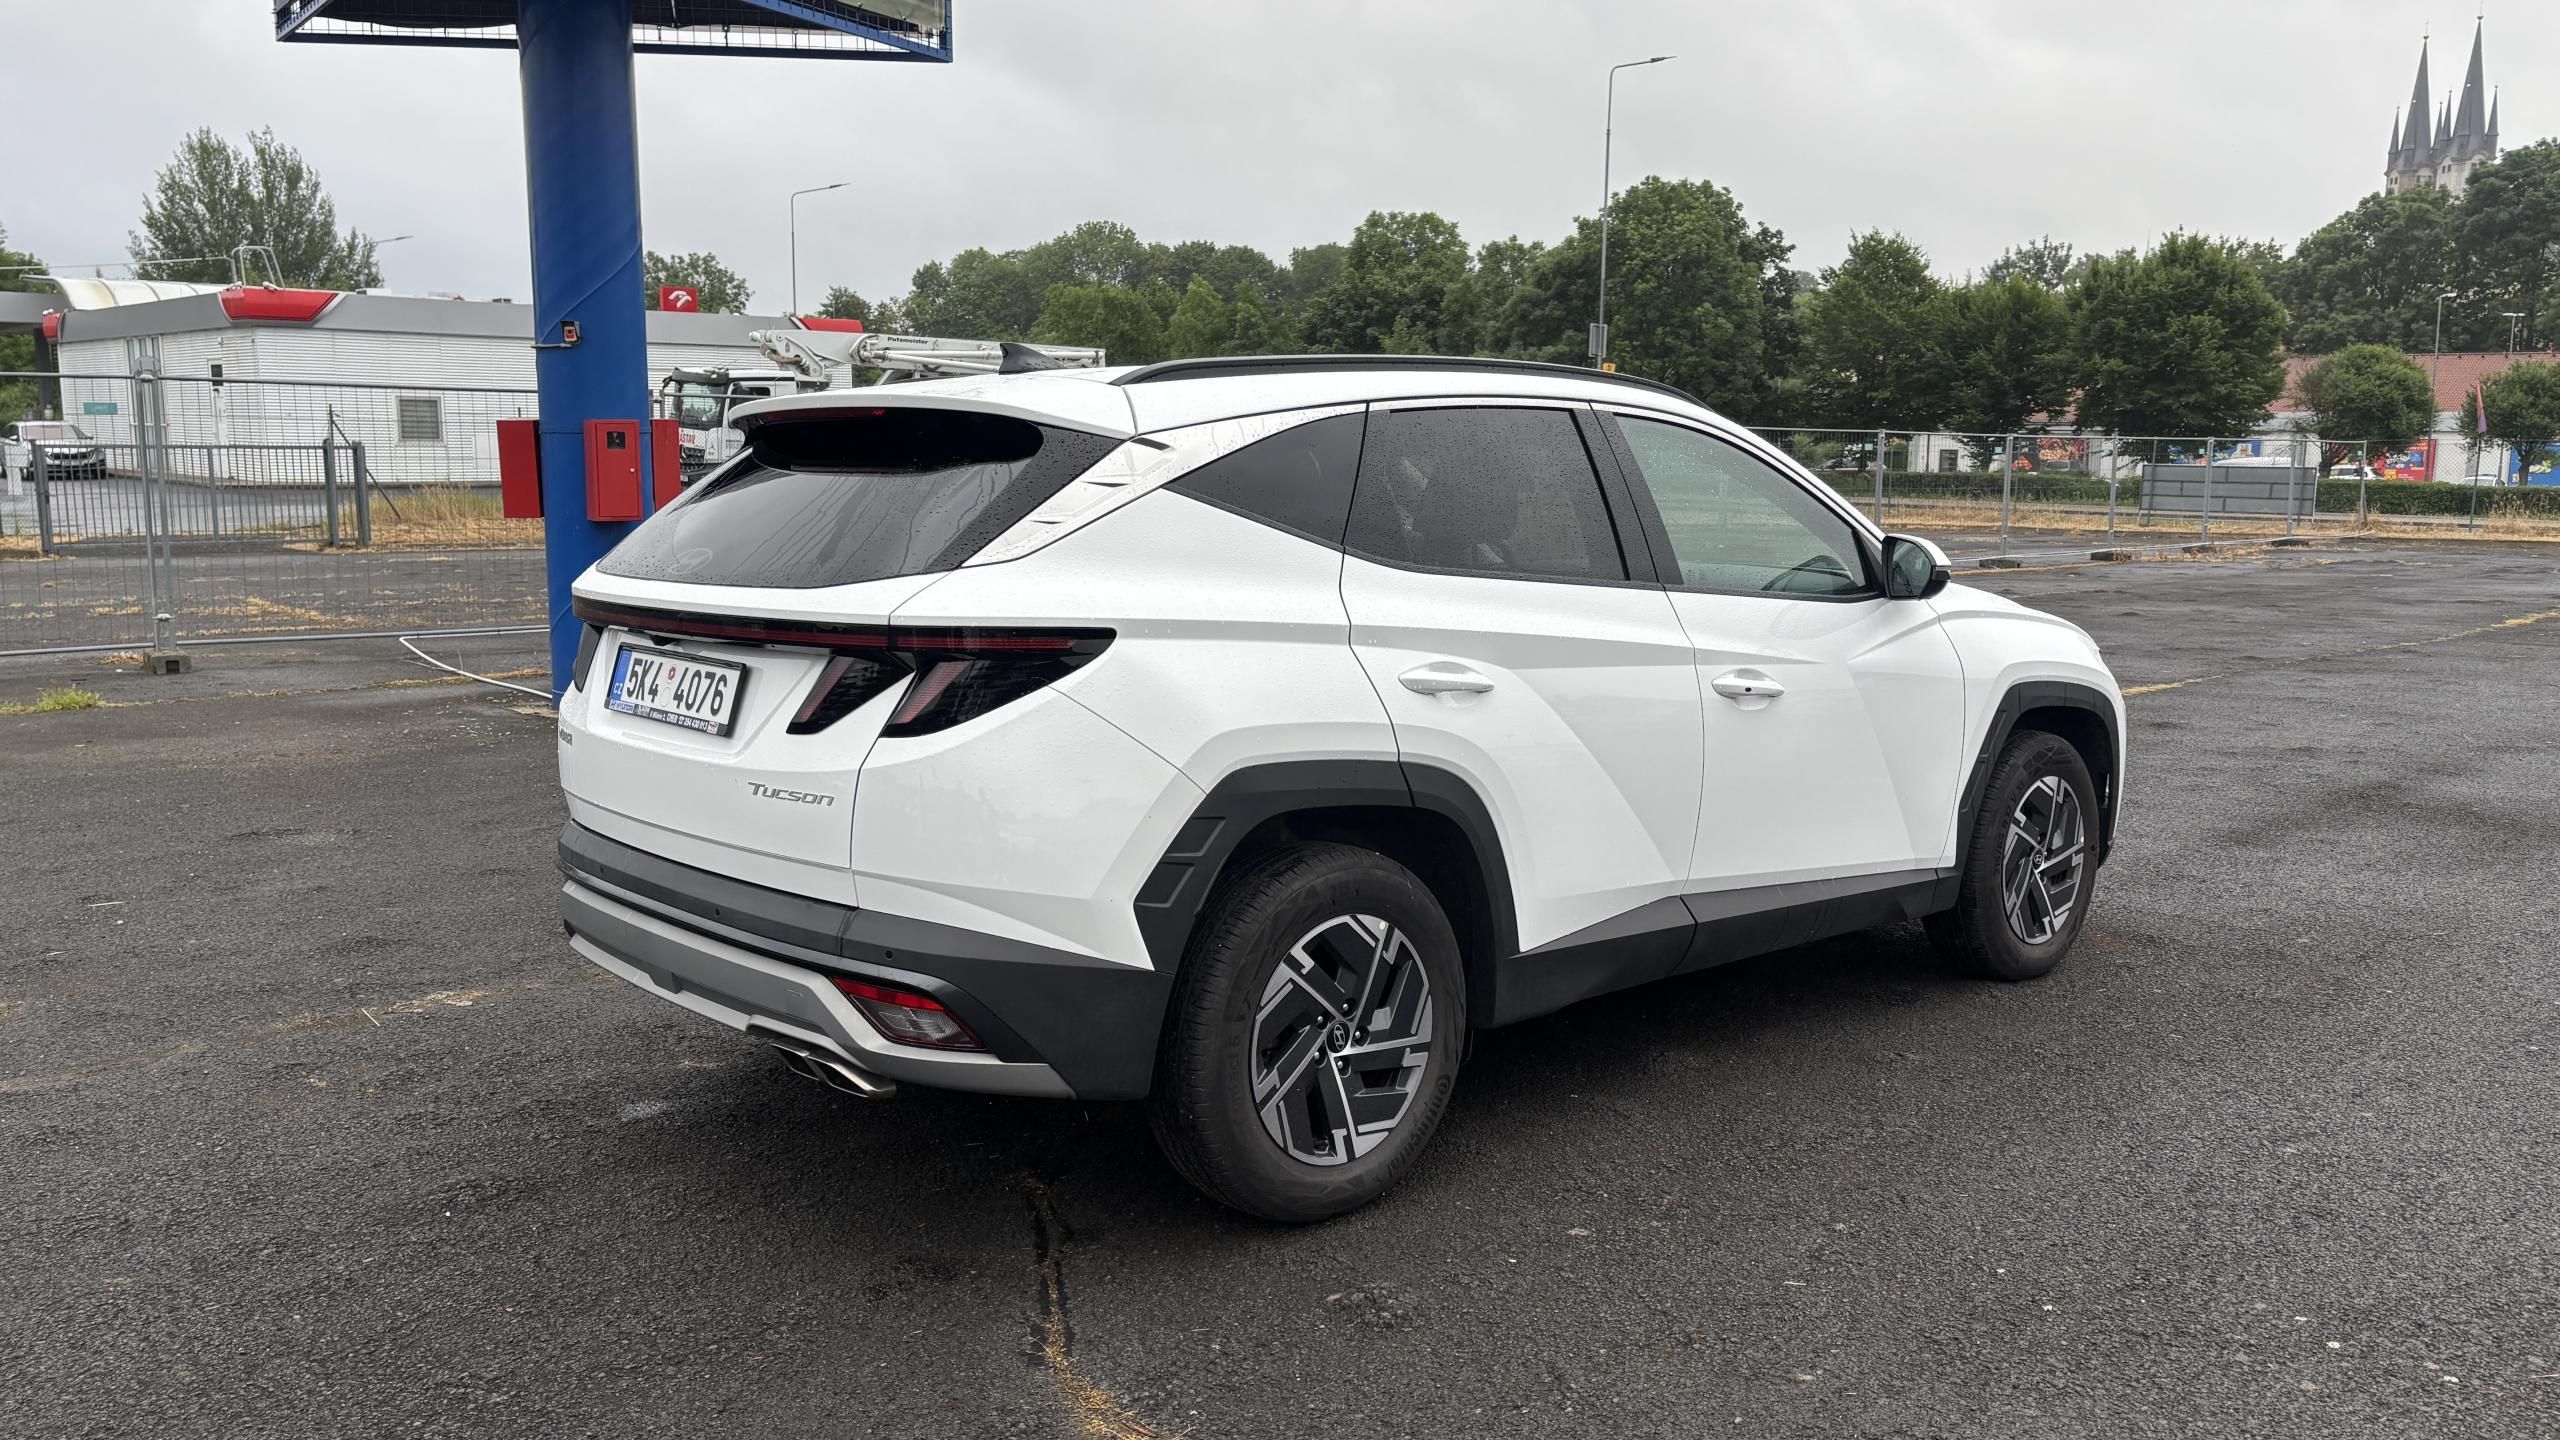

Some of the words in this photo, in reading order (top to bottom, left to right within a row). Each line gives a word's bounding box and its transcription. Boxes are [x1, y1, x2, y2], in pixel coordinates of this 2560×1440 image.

[613, 682, 624, 695] CZ
[627, 657, 663, 704] 5K4
[673, 666, 728, 716] 4076
